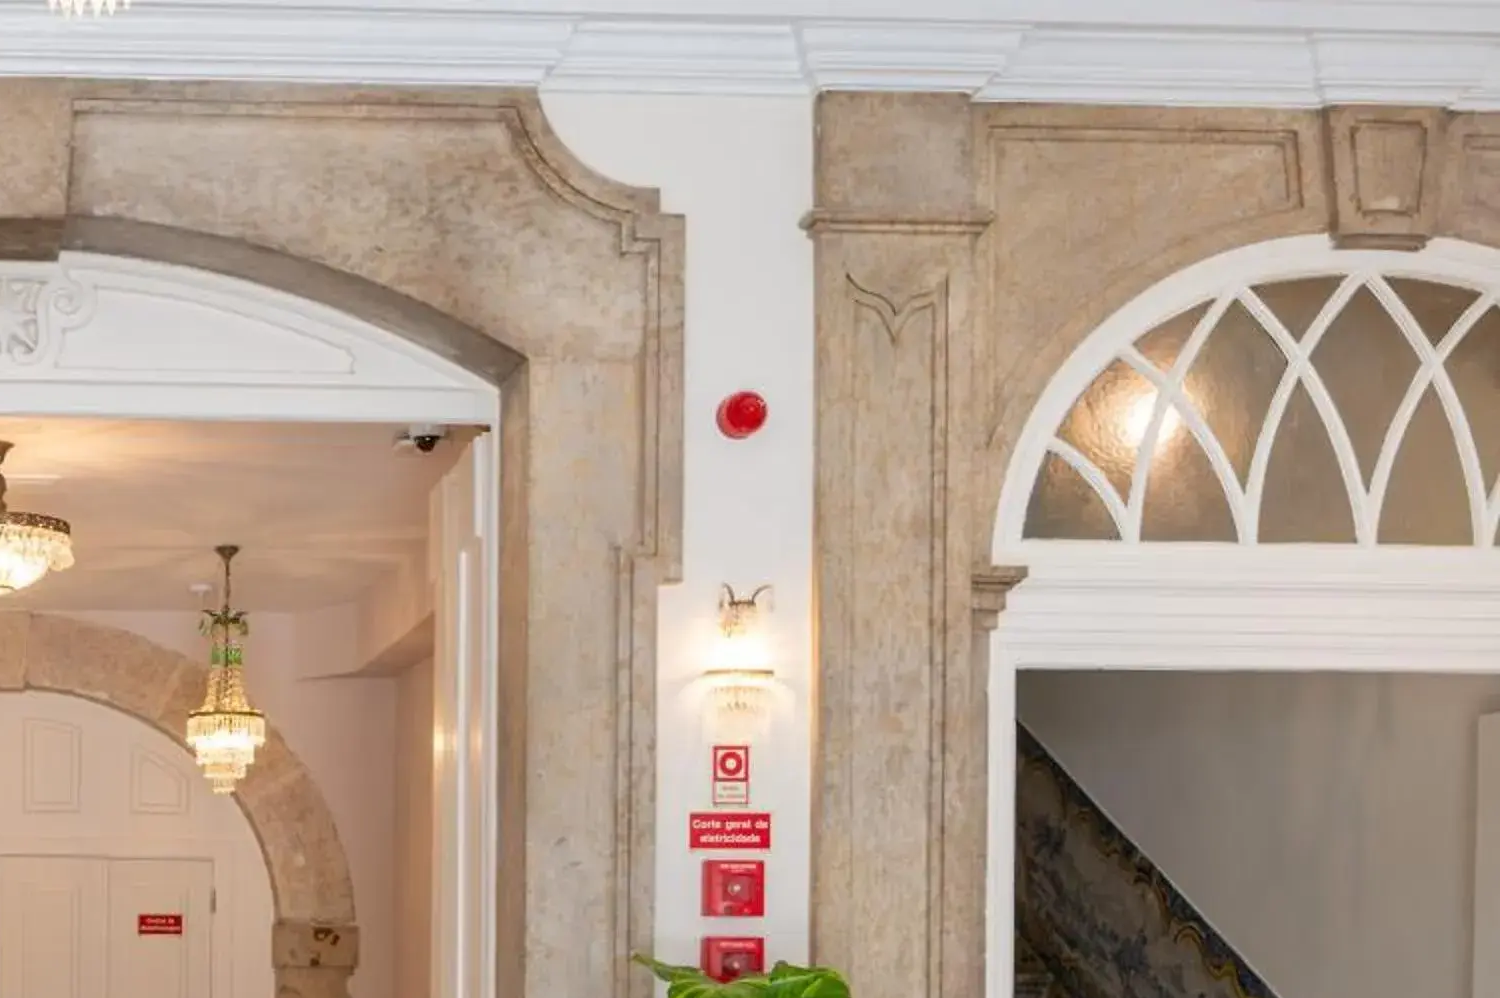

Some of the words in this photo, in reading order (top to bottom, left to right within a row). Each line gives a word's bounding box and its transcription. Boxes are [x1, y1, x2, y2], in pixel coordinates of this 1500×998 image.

[692, 819, 721, 829] Corte
[725, 819, 752, 831] geral
[755, 819, 769, 829] de
